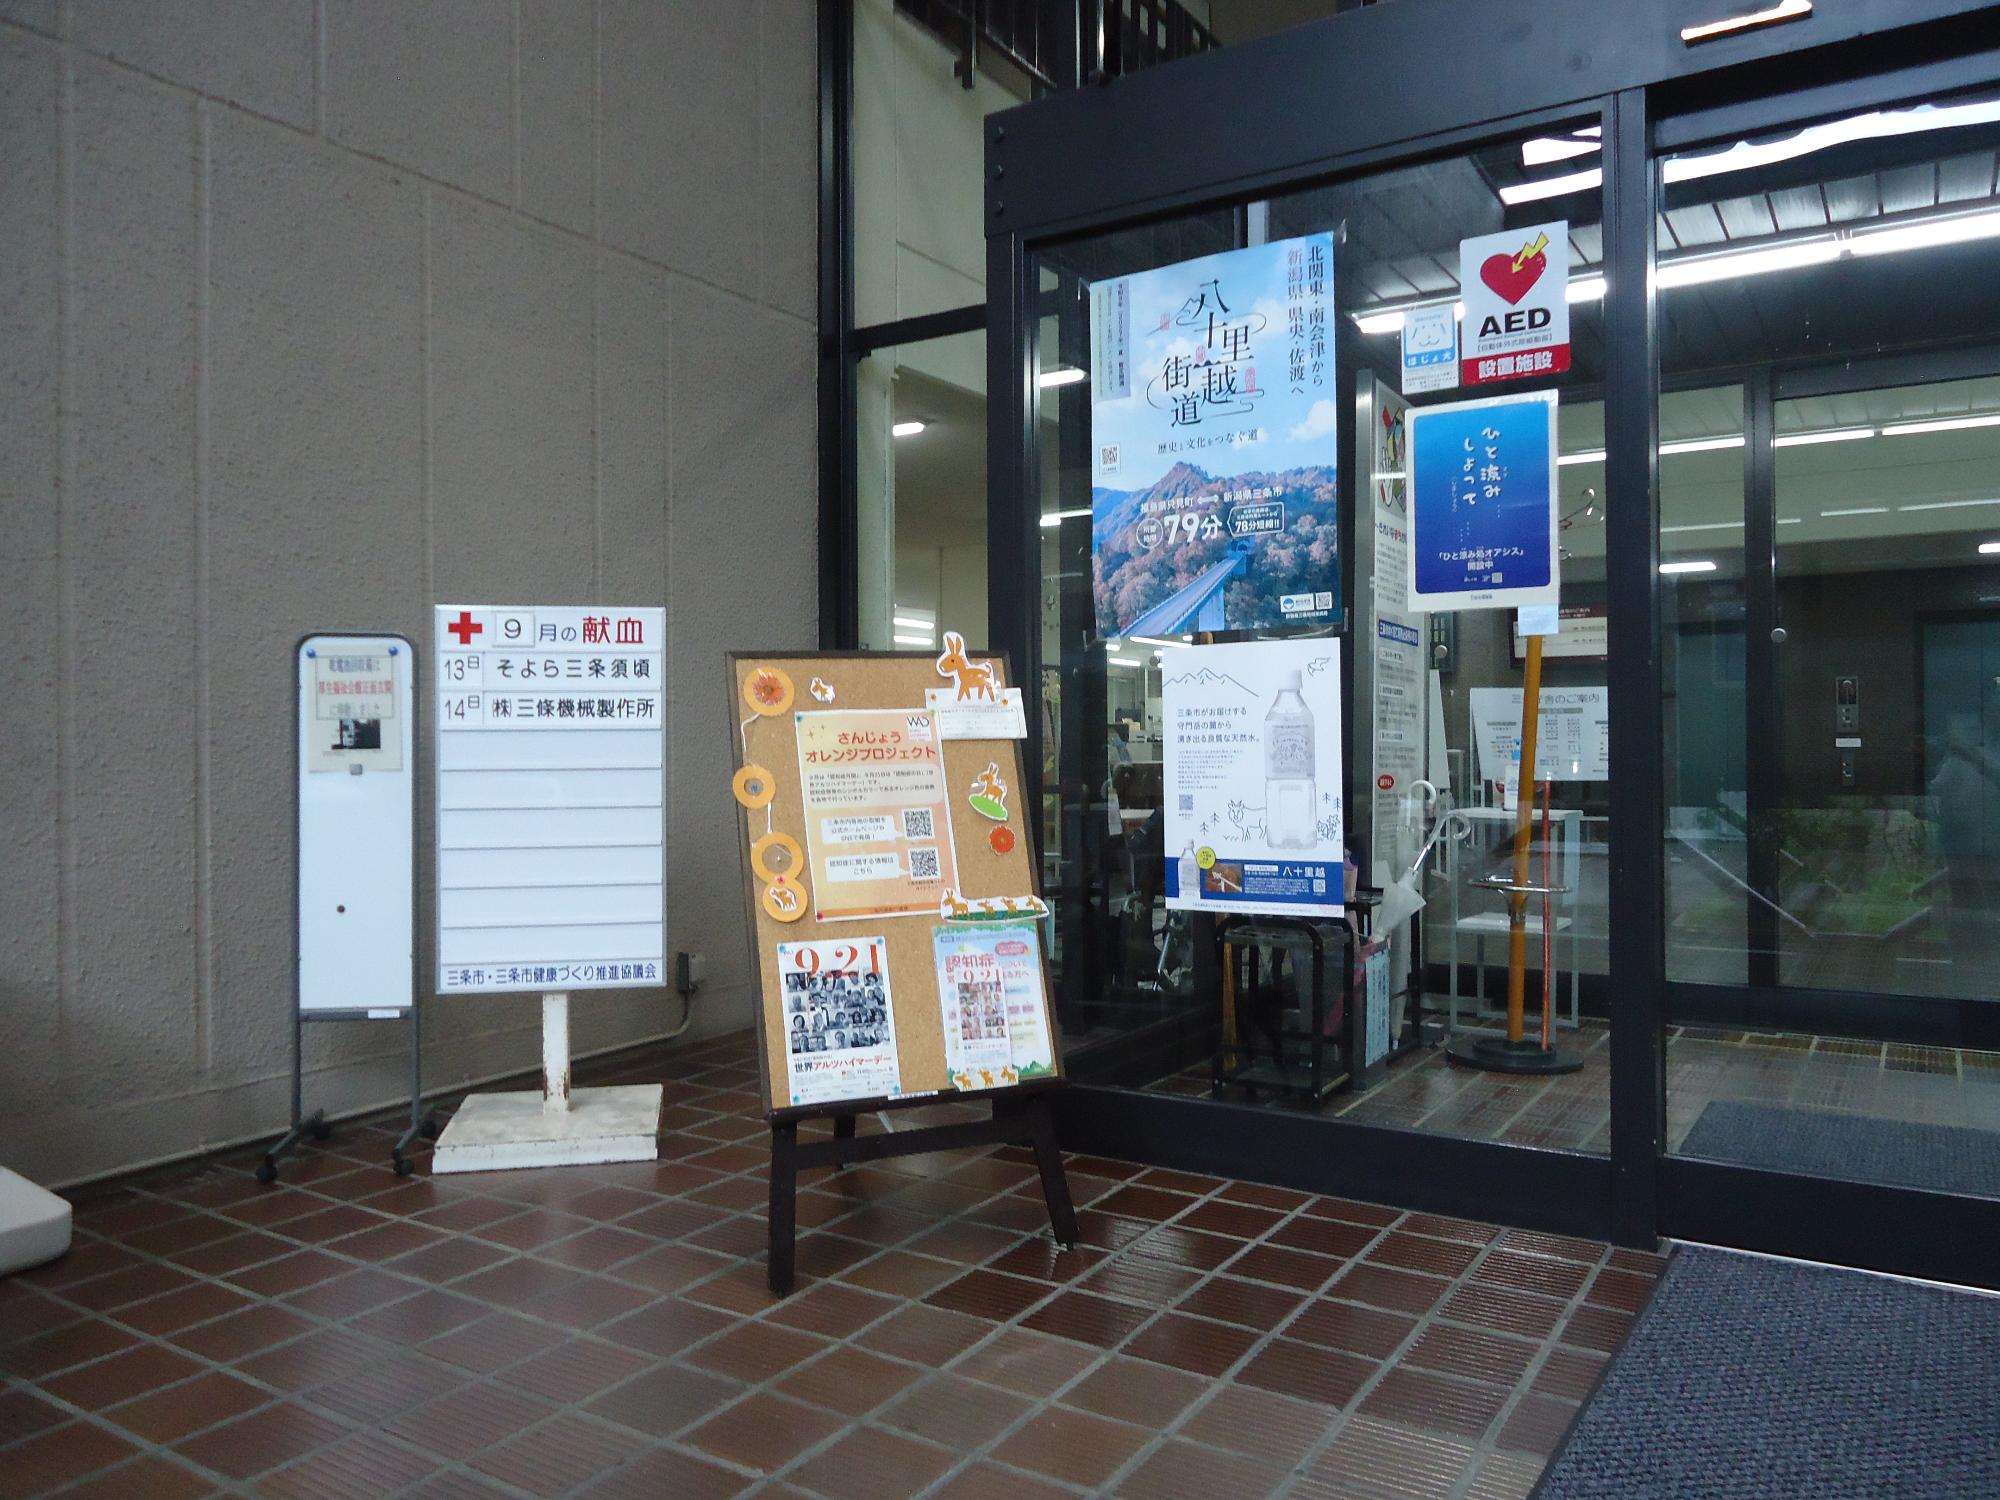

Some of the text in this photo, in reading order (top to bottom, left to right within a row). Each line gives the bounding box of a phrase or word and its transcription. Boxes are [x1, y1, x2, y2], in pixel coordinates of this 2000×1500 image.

[1288, 248, 1304, 300] 新潟県
[1308, 246, 1325, 387] 北関東・南会津から
[1478, 307, 1551, 338] AED
[1407, 351, 1452, 367] ほじょ犬
[1478, 350, 1552, 379] 設置施設
[1158, 428, 1258, 454] 歴史と文化をつなぐ道
[1482, 427, 1501, 498] ひと涼み
[1223, 487, 1282, 503] 新潟県三条市
[1164, 512, 1223, 545] 79分
[1468, 561, 1494, 571] 開設中
[444, 655, 650, 681] 13日 そよら三条須頃
[445, 695, 480, 720] 14日
[1177, 707, 1247, 717] 三条市がお届けする
[1177, 720, 1232, 730] 守門岳の麓から
[838, 730, 902, 744] さんじょう
[805, 746, 936, 763] オレンジプロジェクト
[853, 867, 873, 876] こちら
[1283, 866, 1326, 878] 八十里越
[447, 963, 657, 986] 三条市・三条市健康づくり推進協議会
[794, 1055, 892, 1073] 世界アルツハイマーデー
